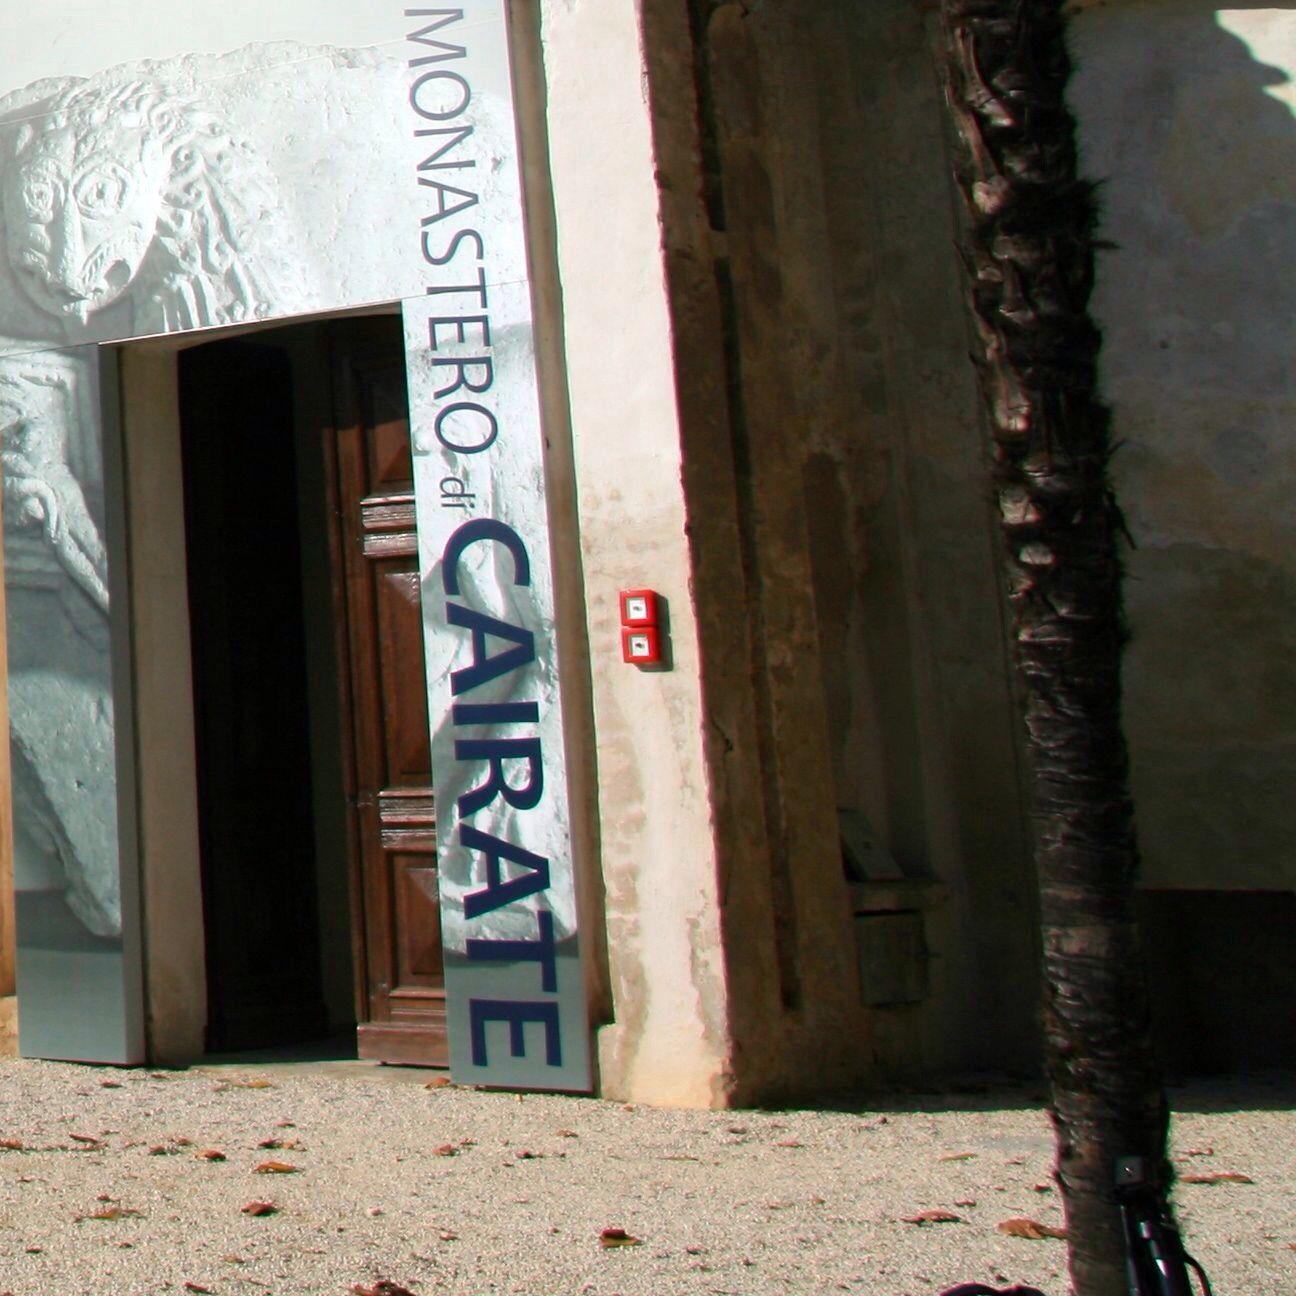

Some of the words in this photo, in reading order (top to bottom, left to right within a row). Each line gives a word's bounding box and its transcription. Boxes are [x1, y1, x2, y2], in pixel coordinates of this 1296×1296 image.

[403, 7, 498, 455] MONASTERO
[439, 476, 475, 509] di
[441, 517, 563, 1068] CAIRATE
